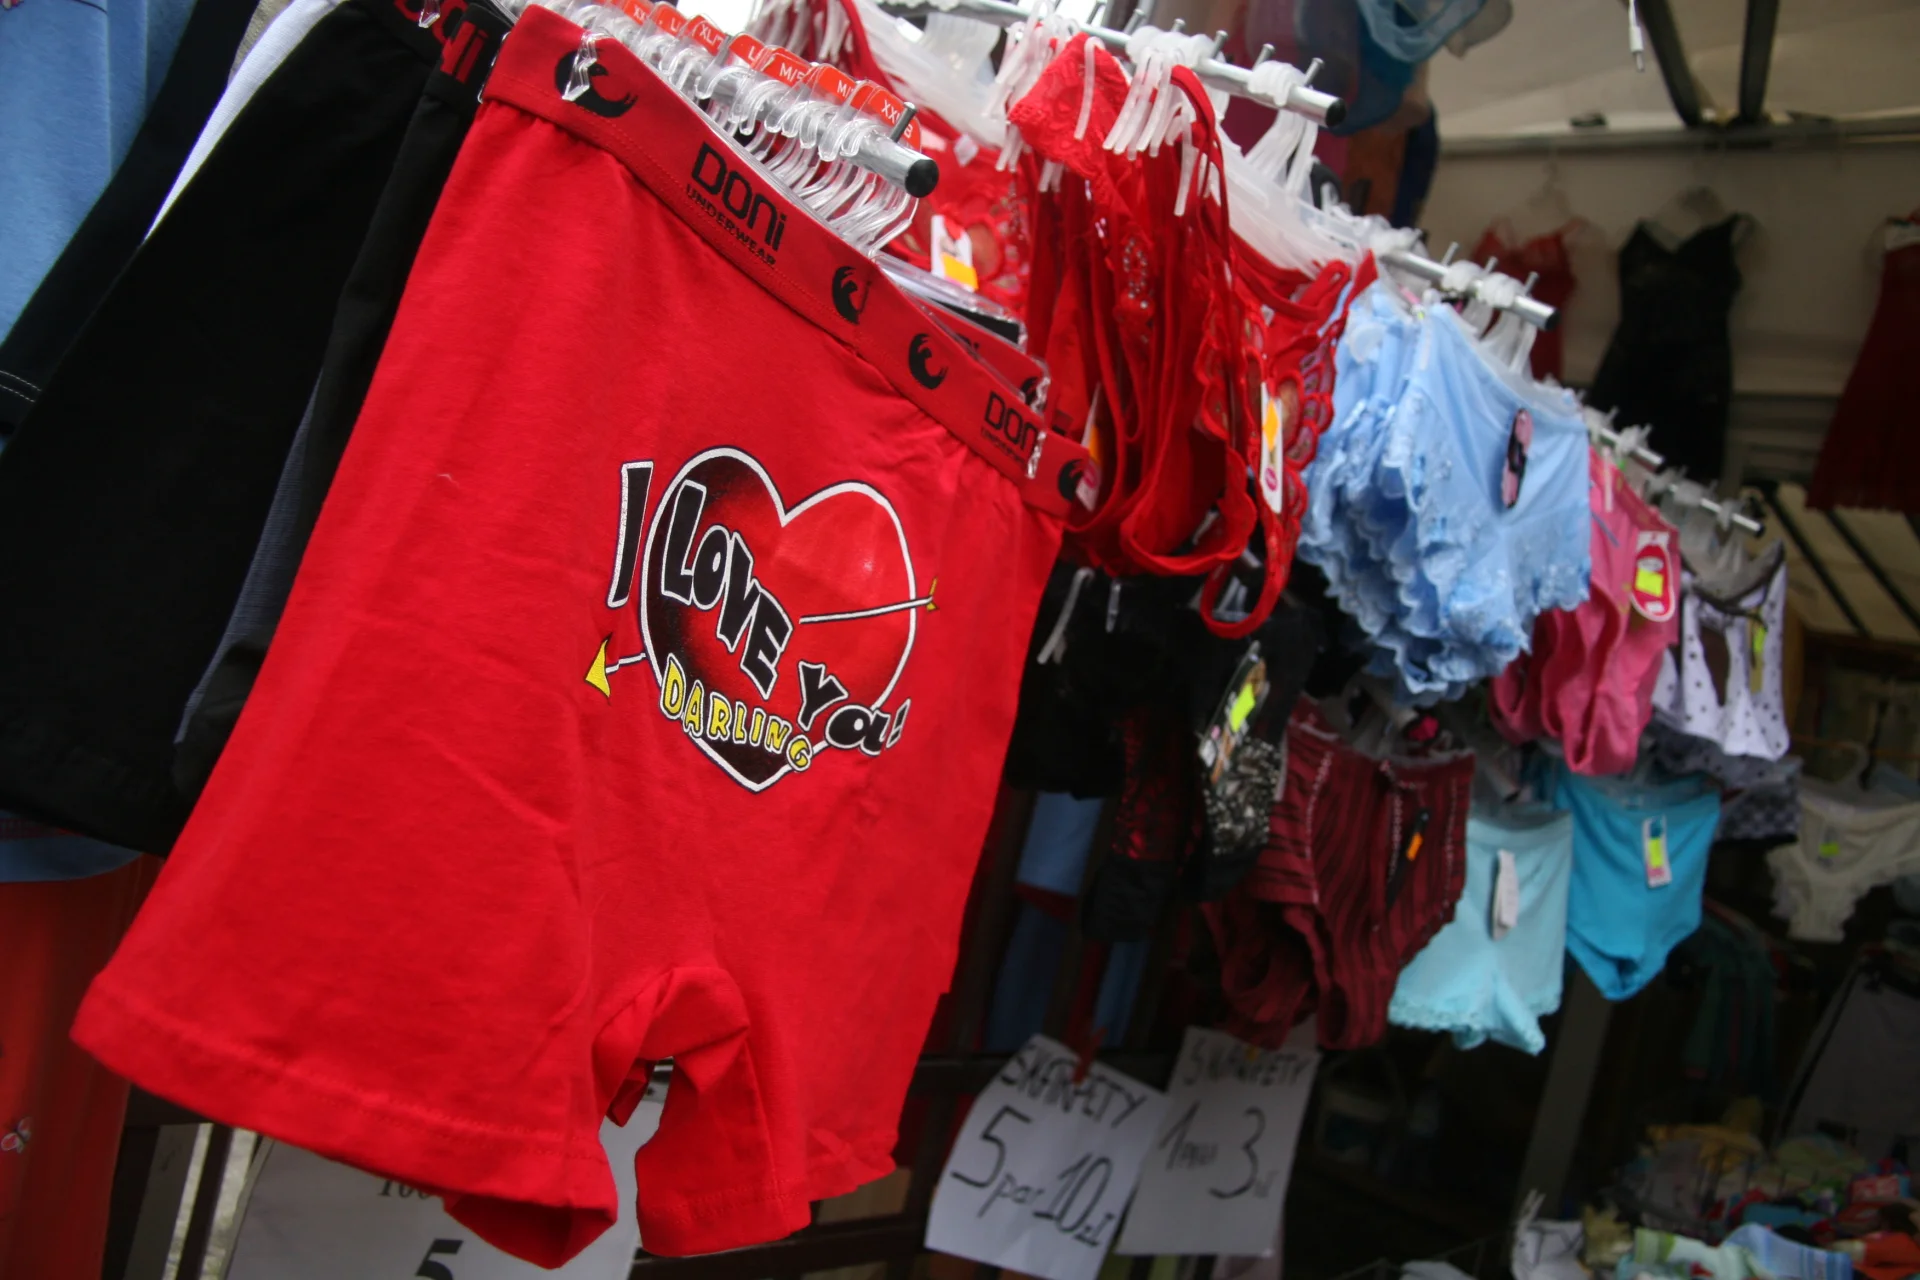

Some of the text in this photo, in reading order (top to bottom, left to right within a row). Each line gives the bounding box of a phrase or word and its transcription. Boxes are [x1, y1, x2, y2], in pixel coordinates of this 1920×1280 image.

[686, 183, 777, 267] UNDERWEAR
[607, 460, 654, 608] I
[659, 653, 812, 772] DARLING
[951, 1104, 1033, 1188] 5
[1033, 1153, 1114, 1233] 10
[1208, 1106, 1267, 1200] 3
